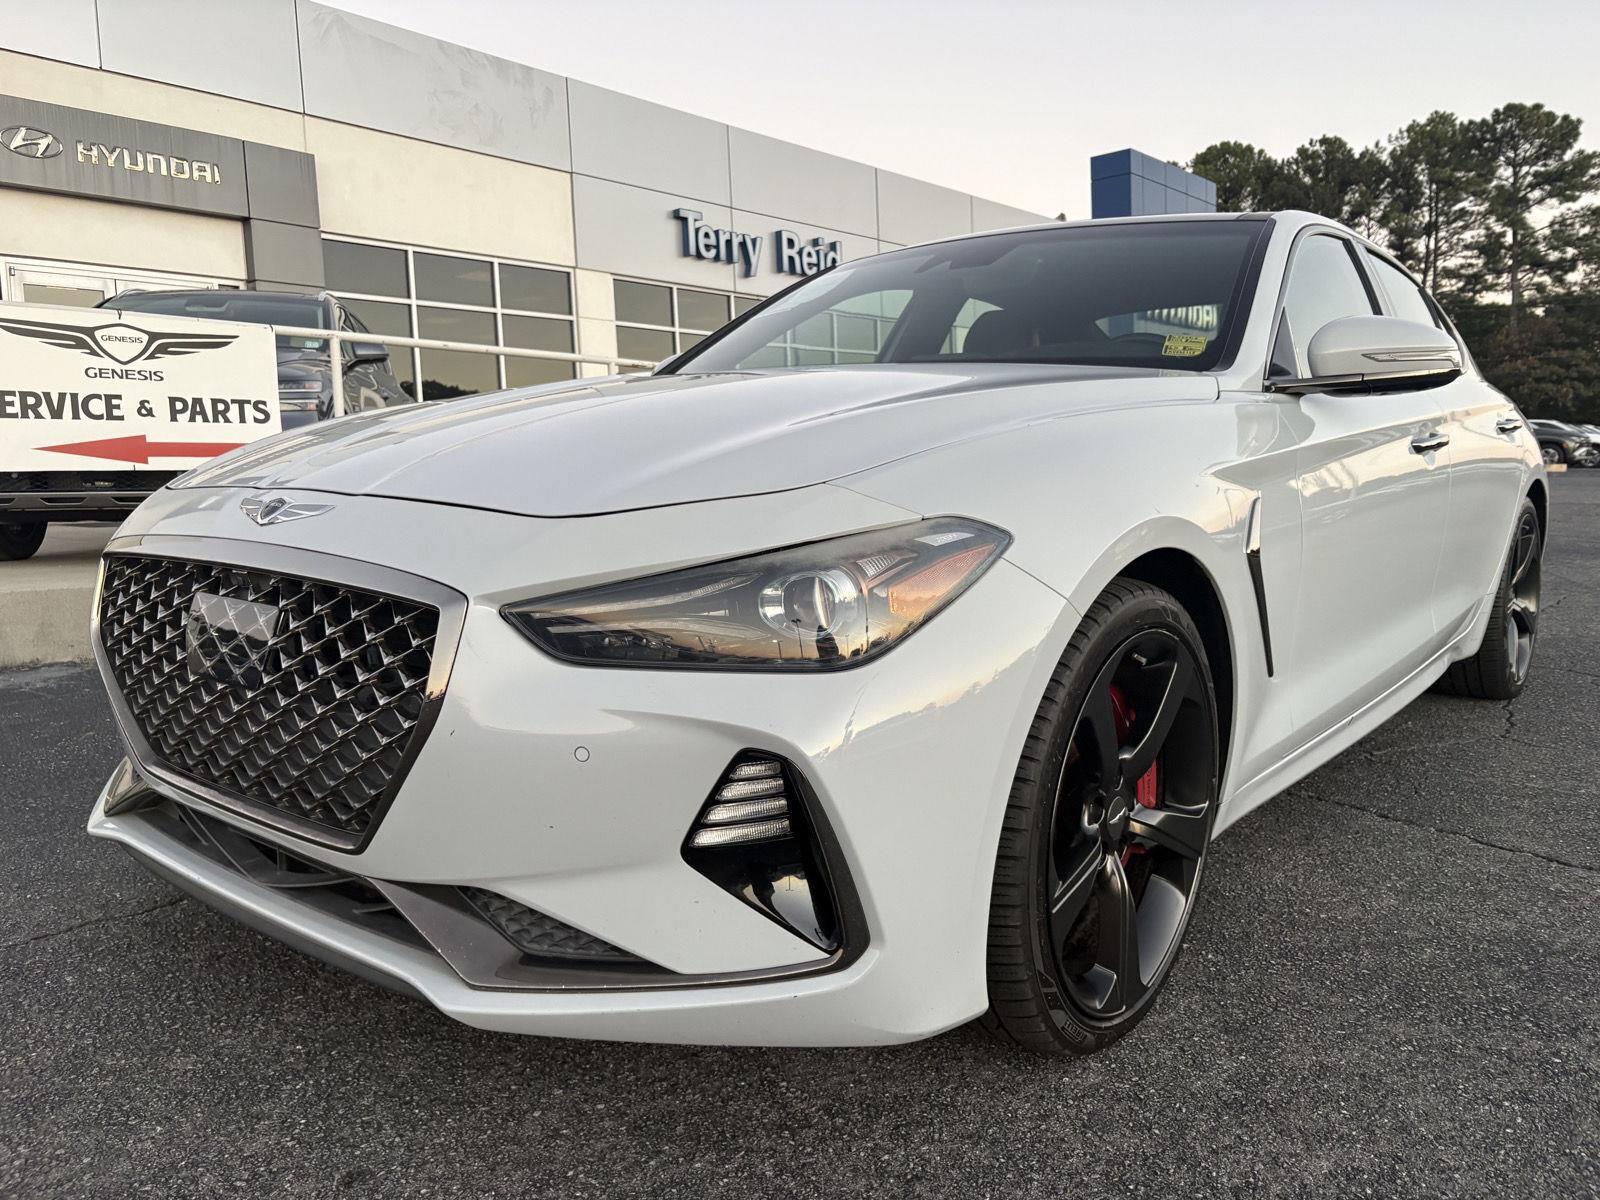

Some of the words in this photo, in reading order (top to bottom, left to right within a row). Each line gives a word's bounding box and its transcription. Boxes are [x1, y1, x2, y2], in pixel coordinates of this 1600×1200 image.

[76, 140, 220, 184] HYUNDAI
[673, 208, 763, 277] Terry
[774, 230, 842, 276] Reid
[101, 335, 143, 344] GENESIS
[85, 367, 164, 382] GENESIS
[136, 400, 156, 418] &
[168, 396, 271, 424] PARTS
